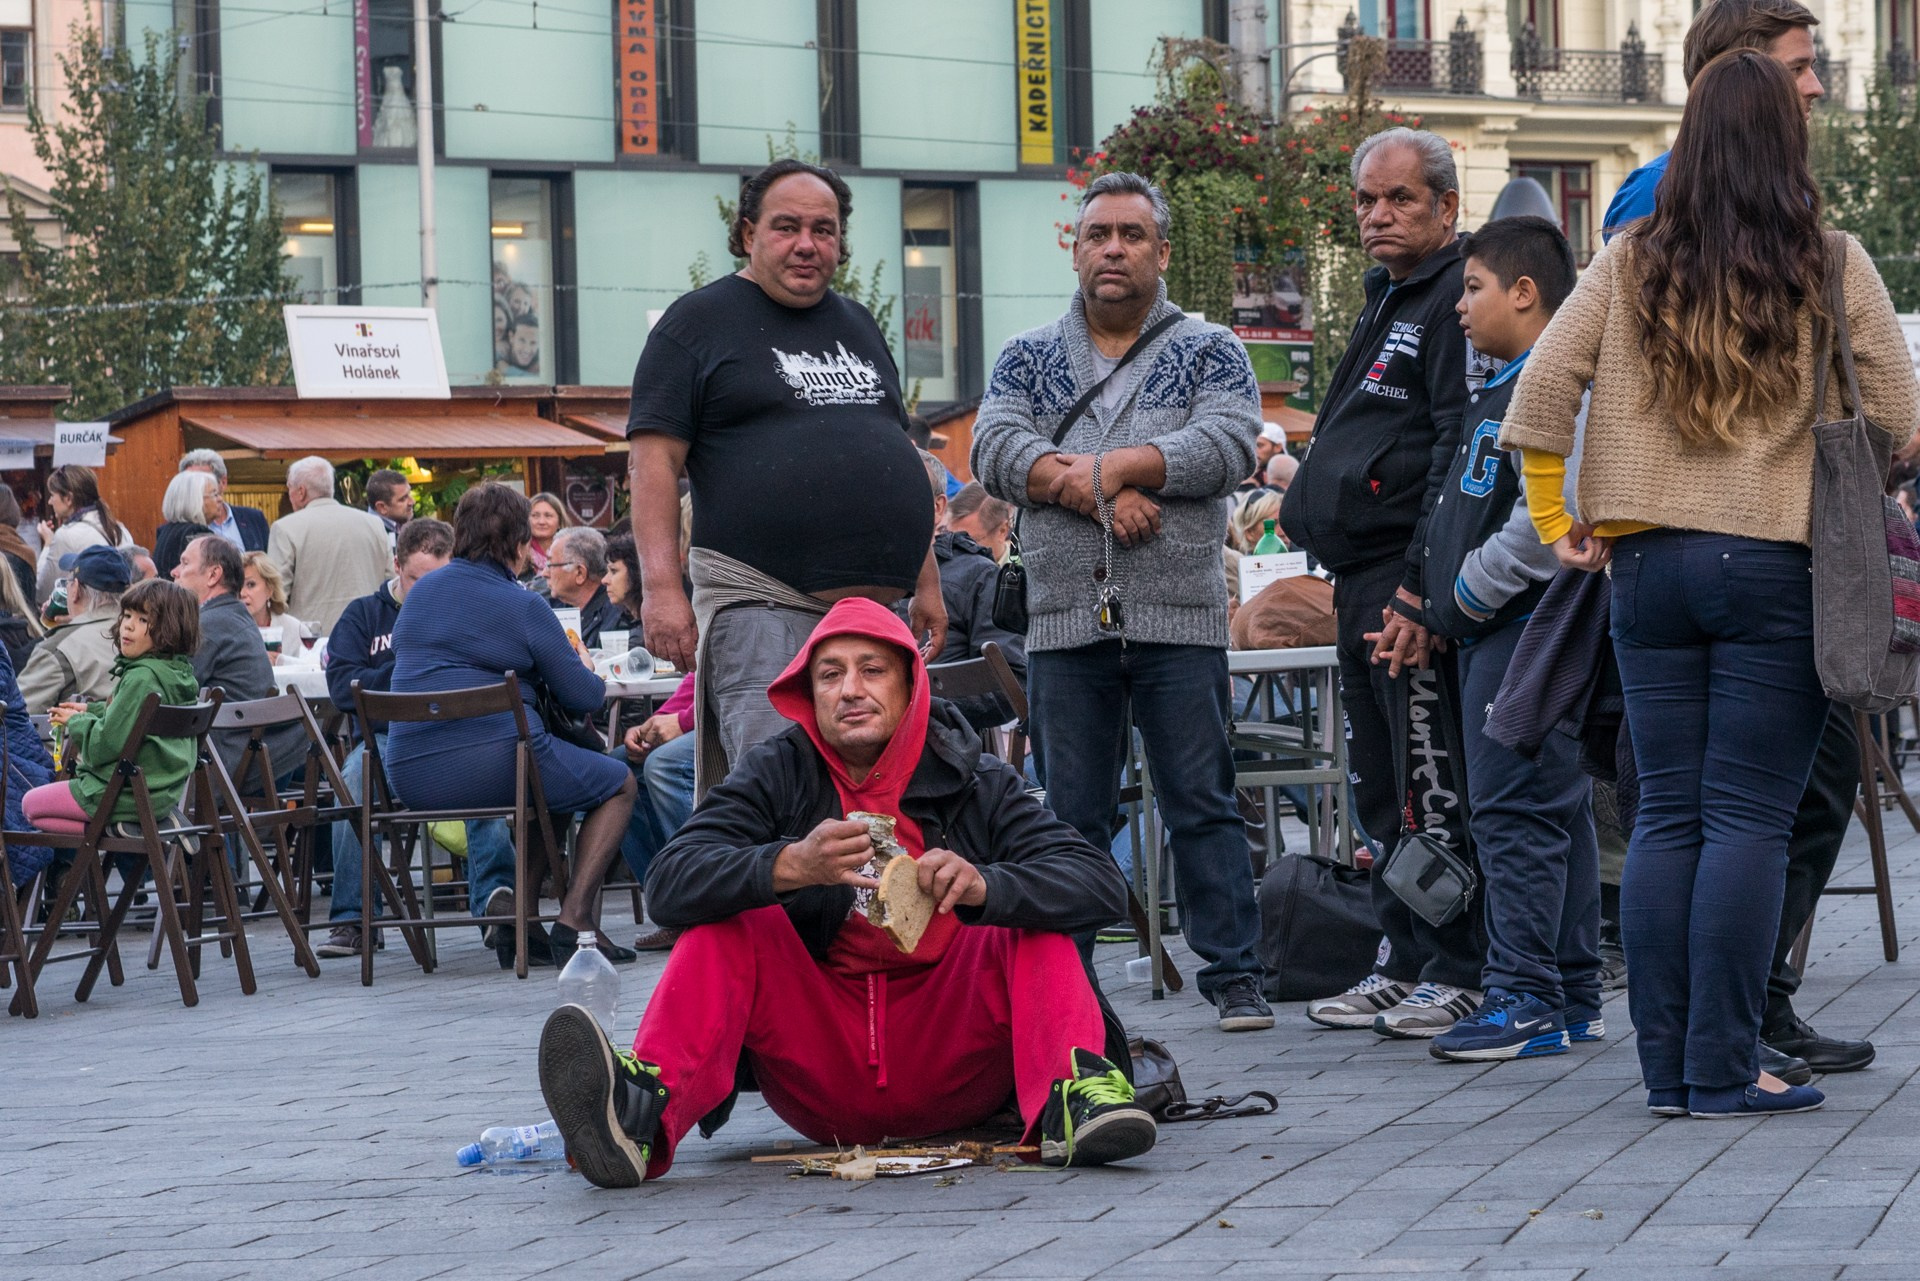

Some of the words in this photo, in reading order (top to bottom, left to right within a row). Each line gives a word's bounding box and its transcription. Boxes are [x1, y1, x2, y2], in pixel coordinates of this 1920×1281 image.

[1022, 0, 1048, 132] KADEŘNICT
[334, 343, 401, 358] Vinařství
[342, 364, 401, 379] Holánek
[60, 430, 103, 444] BURČÁK
